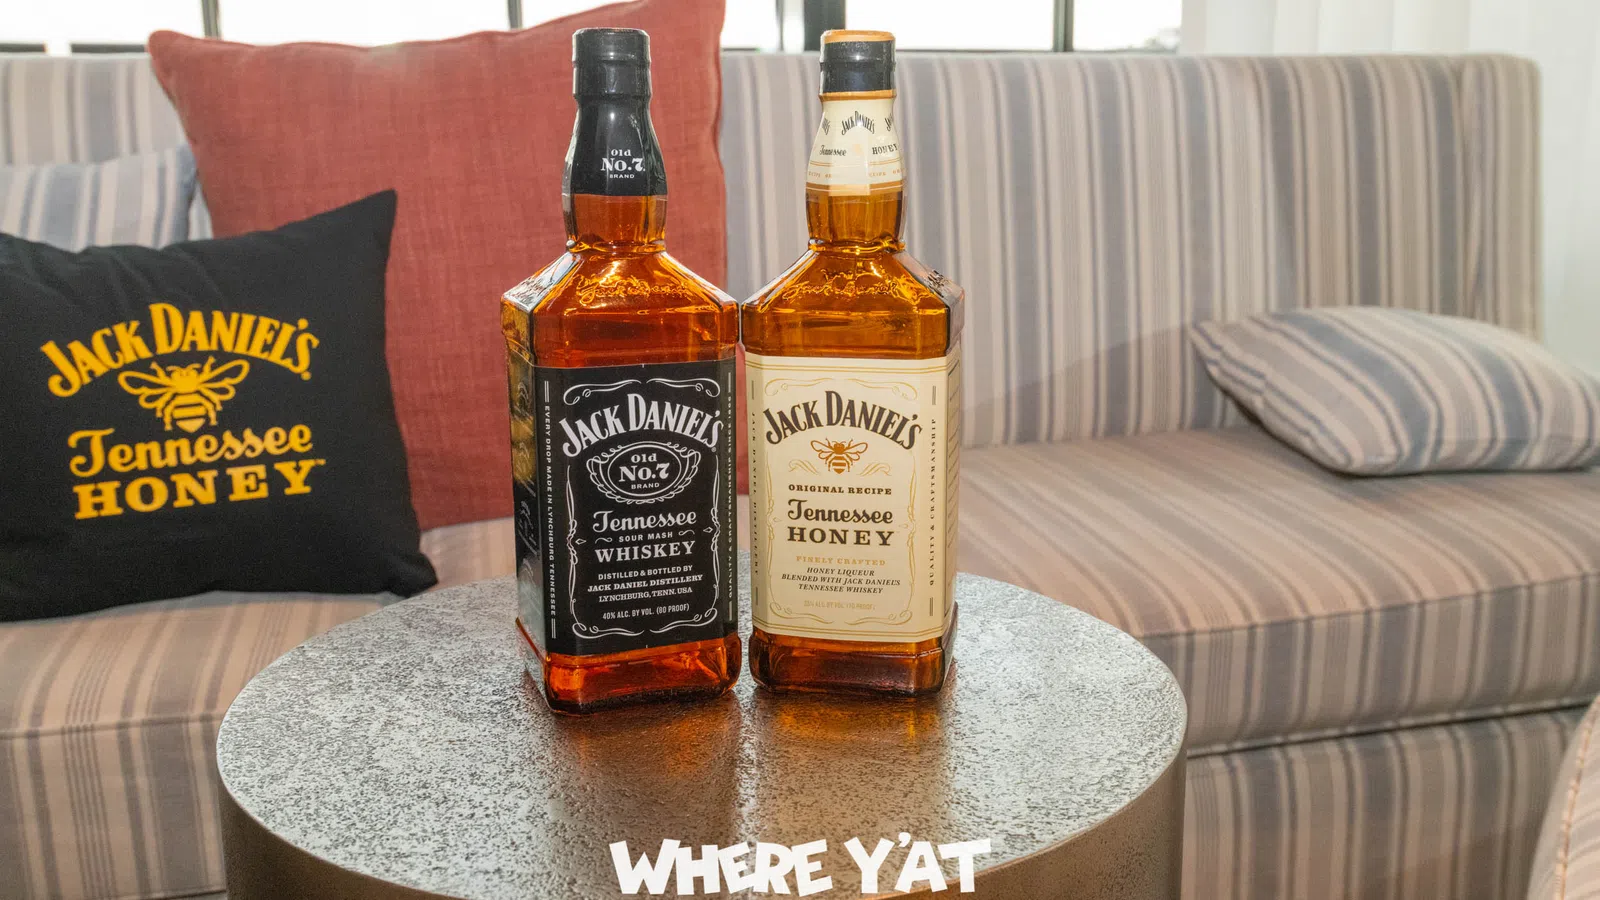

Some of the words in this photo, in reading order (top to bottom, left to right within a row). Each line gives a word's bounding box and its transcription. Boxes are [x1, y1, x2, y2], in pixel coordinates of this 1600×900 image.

[610, 148, 632, 157] Old
[871, 143, 898, 155] HONEY
[41, 320, 153, 397] JACK
[149, 302, 319, 376] DANIEL'S
[558, 404, 627, 458] JACK
[626, 392, 724, 449] DANIEL'S
[763, 400, 824, 445] JACK
[824, 390, 923, 450] DANIEL'S
[67, 424, 313, 478] Tennessee
[630, 453, 657, 463] Old
[618, 462, 670, 483] No.7
[72, 459, 320, 519] HONEY
[631, 482, 660, 490] BRAND
[788, 484, 844, 494] ORIGINAL
[848, 486, 892, 495] RECIPE
[547, 494, 553, 504] IN
[787, 498, 893, 524] Tennessee
[592, 510, 697, 533] Tennessee
[547, 506, 555, 561] LYNCHBURG
[618, 534, 643, 543] SOUR
[647, 531, 673, 541] MASH
[787, 526, 895, 546] HONEY
[594, 540, 696, 563] WHISKEY
[796, 555, 834, 564] FINELY
[836, 557, 886, 566] CRAFTED
[598, 570, 639, 581] DISTILLED
[639, 569, 646, 577] &
[647, 566, 682, 576] BOTTLED
[683, 564, 693, 572] BY
[781, 573, 819, 583] BLENDED
[820, 576, 842, 584] WITH
[843, 577, 864, 585] JACK
[865, 578, 901, 586] DANIEL'S
[806, 566, 836, 575] HONEY
[837, 569, 875, 577] LIQUEUR
[587, 584, 611, 592] JACK
[613, 580, 649, 590] DANIEL
[649, 574, 704, 587] DISTILLERY
[798, 583, 845, 592] TENNESSEE
[846, 586, 883, 594] WHISKEY
[598, 591, 652, 603] LYNCHBURG,
[652, 588, 676, 597] TENN.
[677, 586, 693, 595] USA
[602, 611, 616, 620] 40%
[616, 610, 631, 619] ALC.
[632, 609, 640, 617] BY
[641, 608, 655, 616] VOL.
[656, 606, 667, 615] (80
[667, 603, 690, 613] PROOF)
